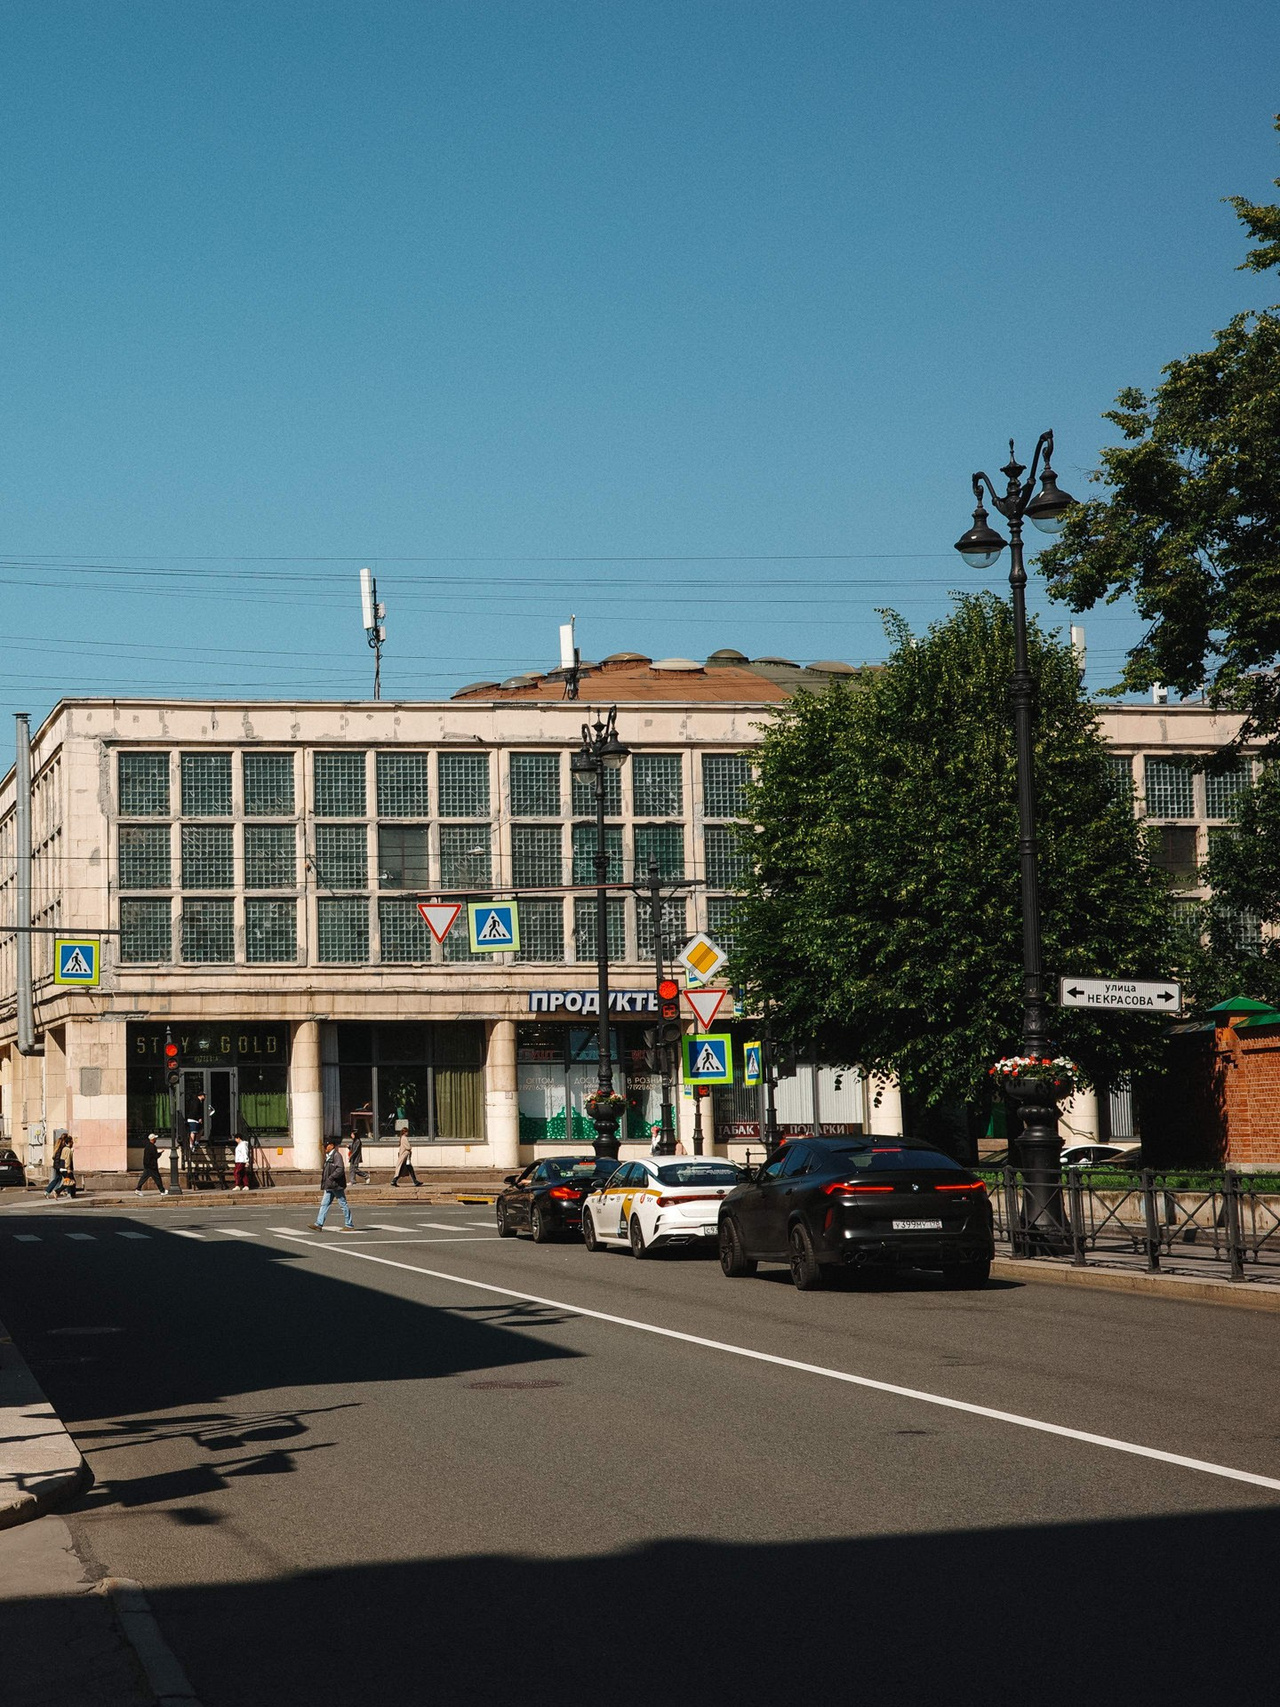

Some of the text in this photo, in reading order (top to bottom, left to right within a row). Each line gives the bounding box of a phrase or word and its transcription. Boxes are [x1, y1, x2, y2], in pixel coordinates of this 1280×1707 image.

[1105, 984, 1137, 994] улица
[1087, 994, 1154, 1006] НЕКРАСОВА
[136, 1035, 277, 1054] STY GOLD
[626, 1076, 674, 1084] В РОЗНИУ
[716, 1125, 755, 1135] ТАБАК
